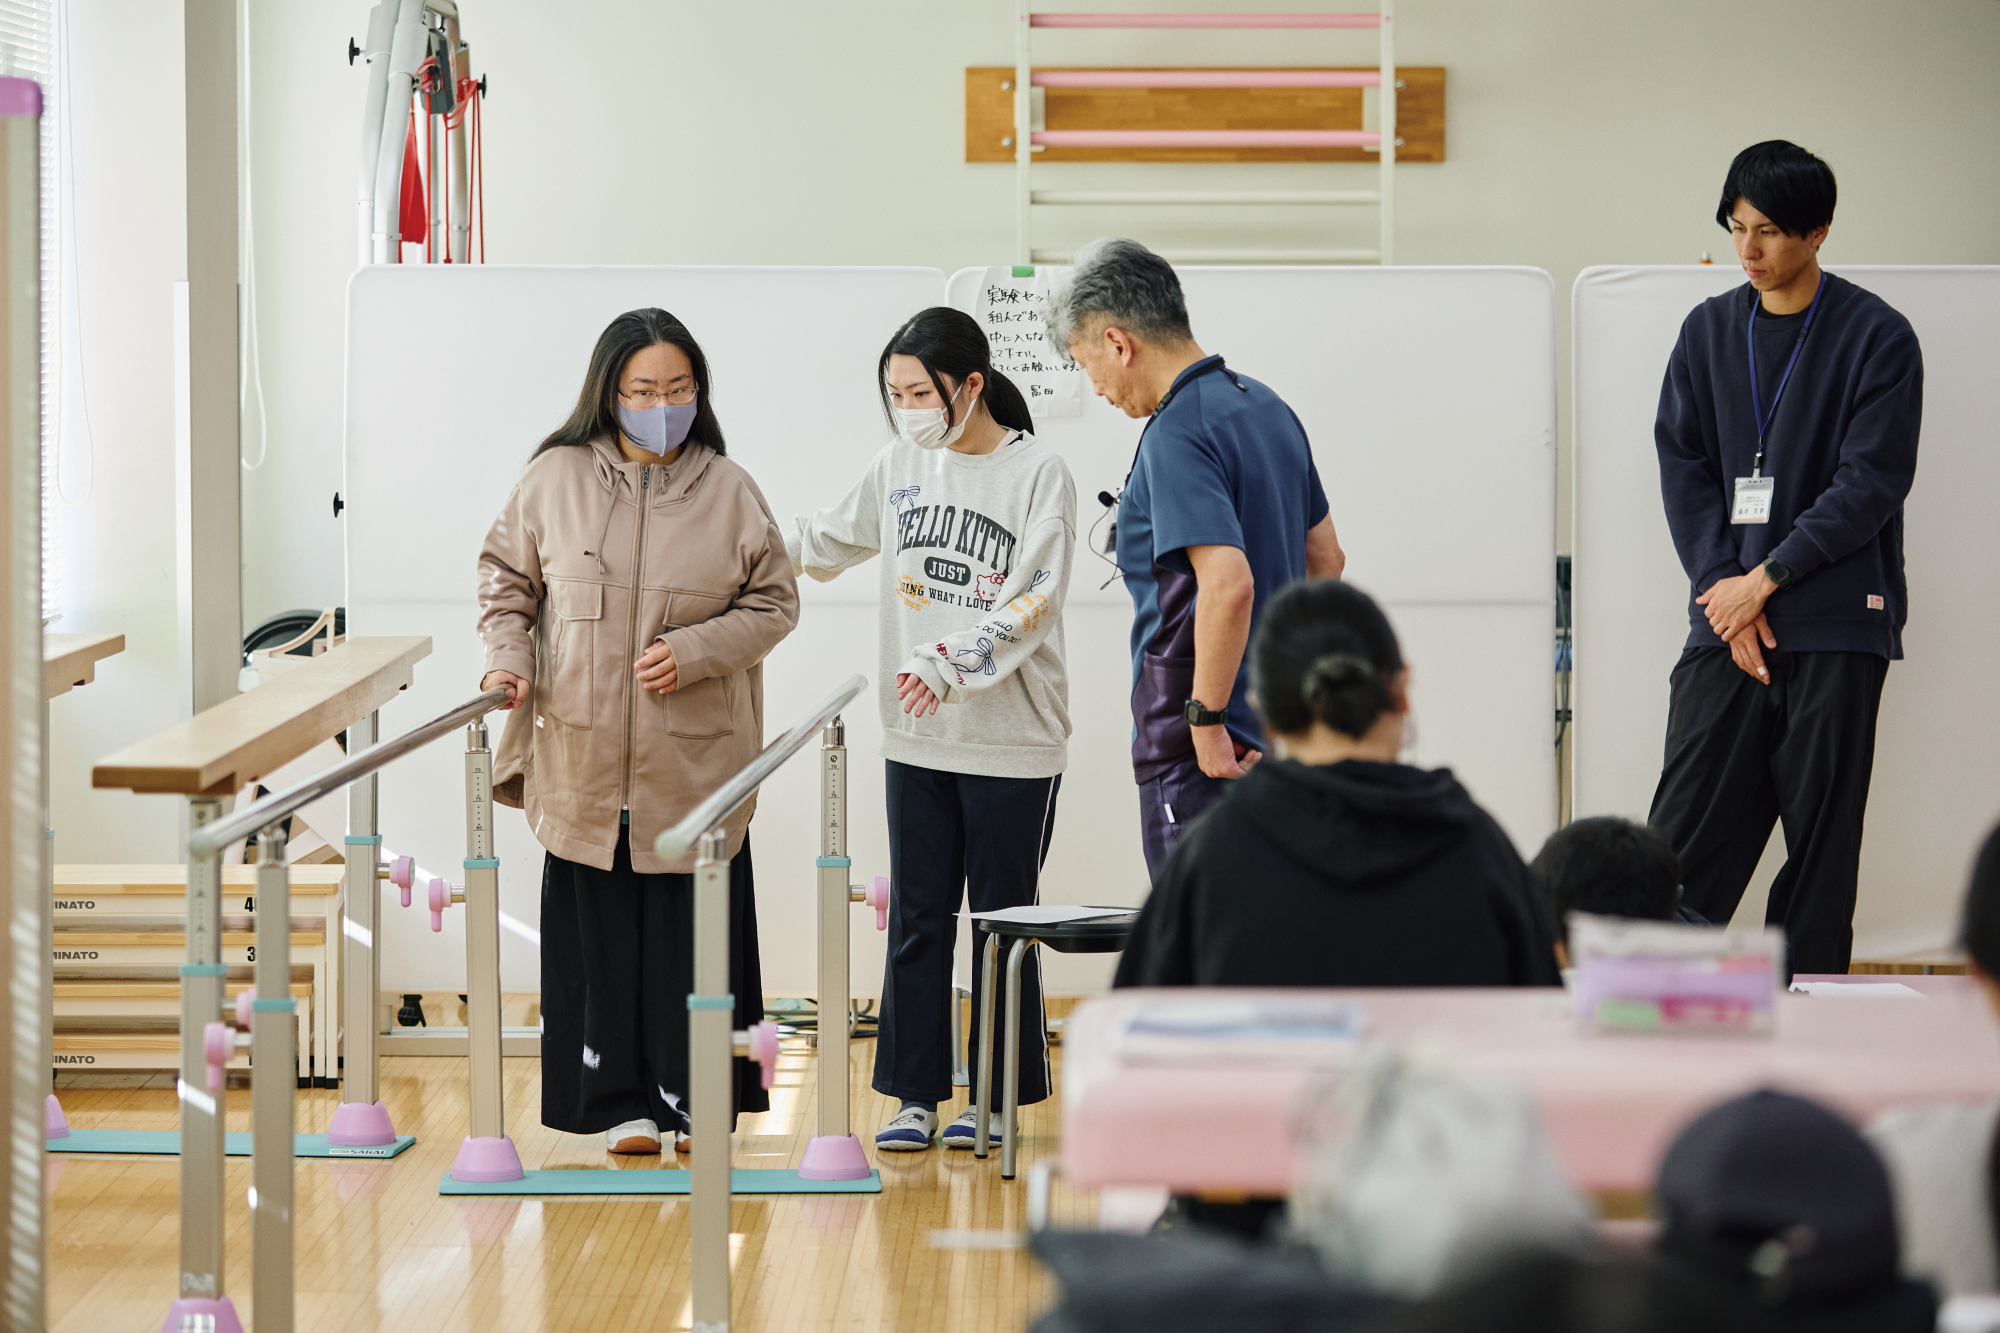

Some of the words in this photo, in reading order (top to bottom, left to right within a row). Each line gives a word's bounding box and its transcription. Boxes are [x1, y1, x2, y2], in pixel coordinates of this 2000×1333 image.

[987, 310, 1044, 325] 組んであ
[896, 504, 956, 556] HELLO
[954, 508, 1017, 579] KITTY
[929, 560, 966, 582] JUST
[928, 587, 955, 604] WHAT
[957, 595, 962, 606] I
[965, 596, 993, 612] LOVE
[53, 900, 96, 910] INATO
[244, 896, 257, 913] 4
[53, 1055, 96, 1065] INATO
